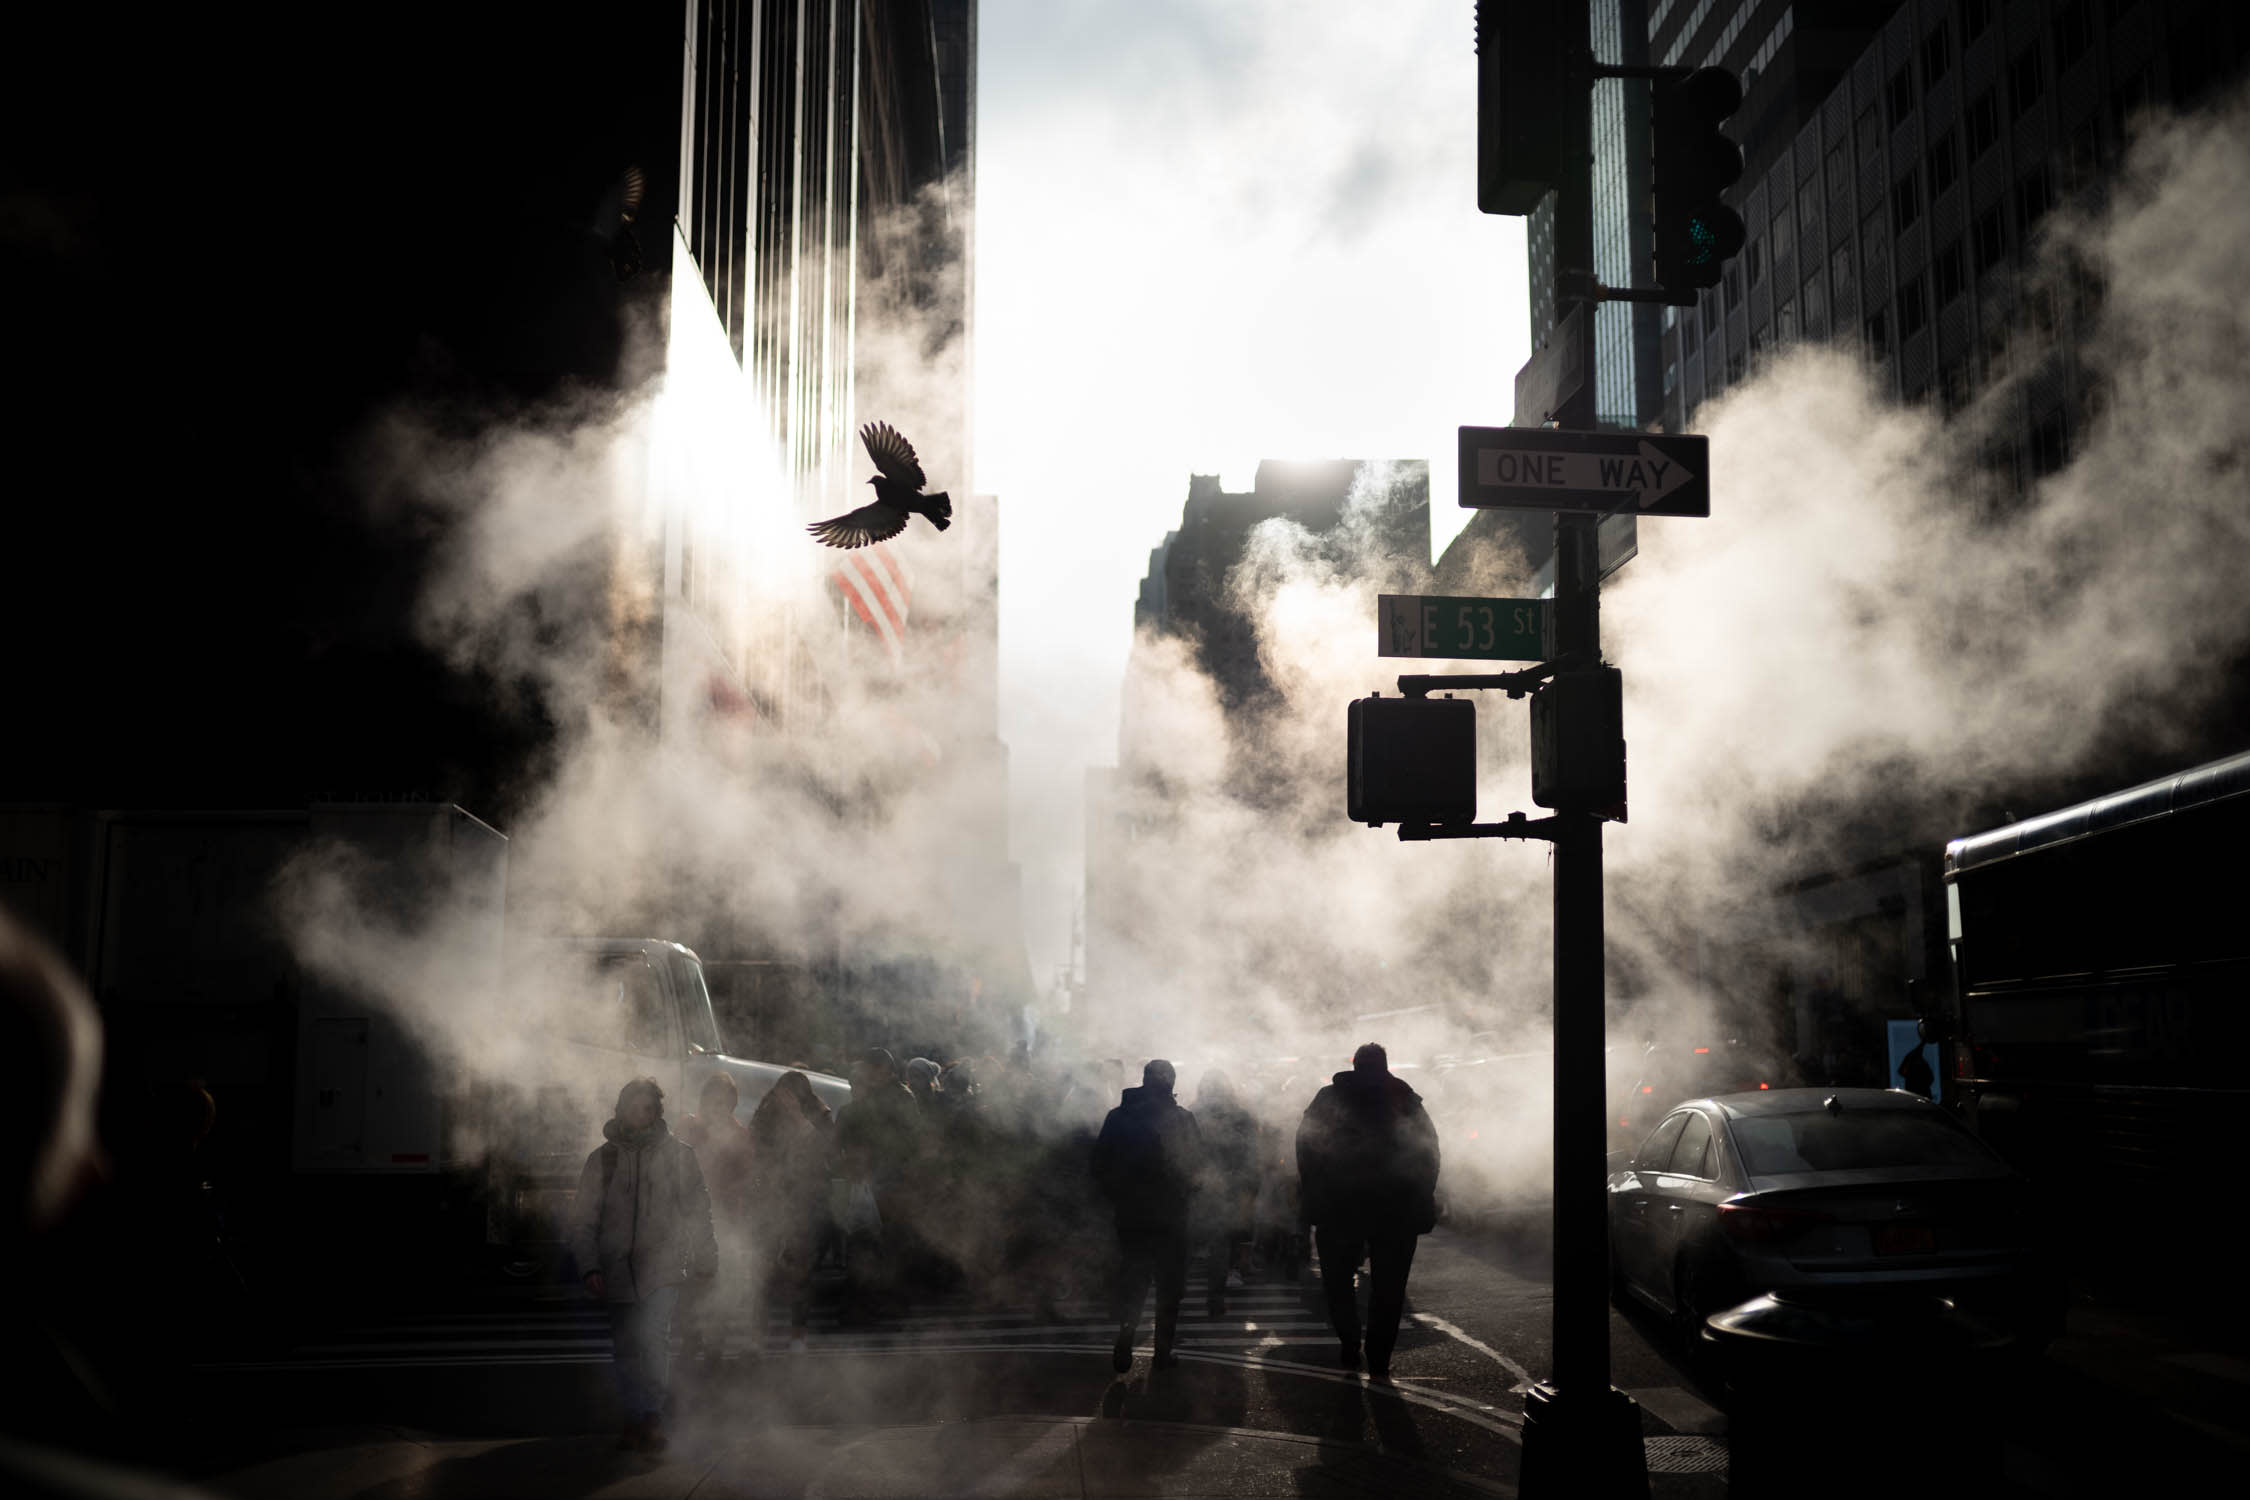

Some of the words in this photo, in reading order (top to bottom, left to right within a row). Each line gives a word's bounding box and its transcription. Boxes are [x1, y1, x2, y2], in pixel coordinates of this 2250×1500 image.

[1497, 453, 1566, 485] ONE
[1599, 458, 1671, 489] WAY
[1422, 604, 1440, 649] E
[1457, 605, 1496, 651] 53
[1512, 606, 1537, 636] St
